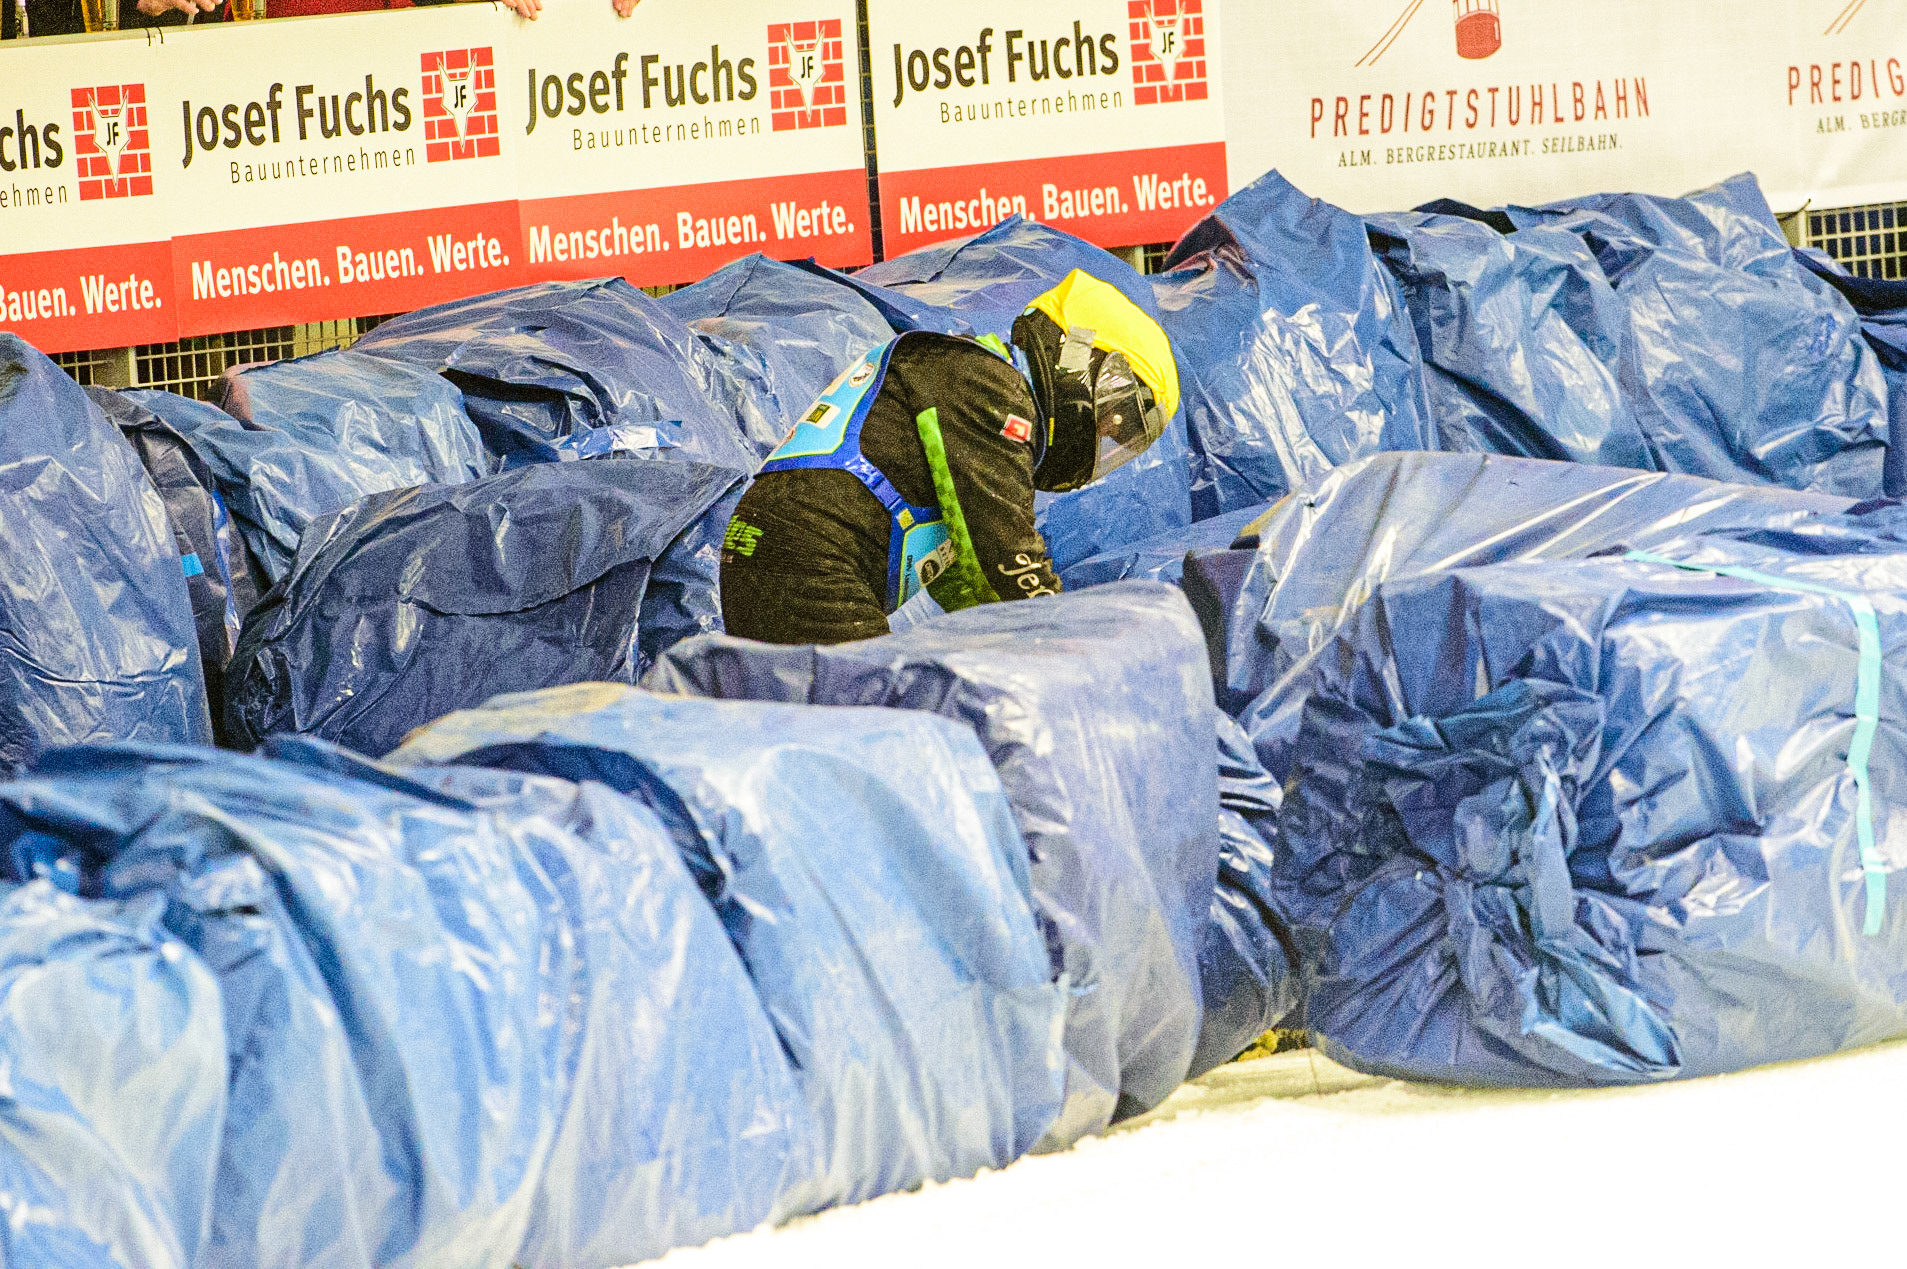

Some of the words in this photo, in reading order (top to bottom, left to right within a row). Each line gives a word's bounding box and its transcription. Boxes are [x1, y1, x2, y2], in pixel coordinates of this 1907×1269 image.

[1162, 31, 1176, 55] JF
[801, 55, 815, 80] JF
[893, 27, 993, 109] Josef
[1005, 20, 1119, 82] Fuchs
[455, 85, 466, 108] JF
[526, 52, 629, 135] Josef
[641, 45, 756, 108] Fuchs
[940, 89, 1121, 124] Bauunternehmen
[1310, 77, 1650, 139] PREDIGTSTUHLBAHN
[107, 122, 118, 145] JF
[183, 83, 282, 168] Josef
[296, 74, 411, 140] Fuchs
[573, 115, 759, 152] Bauunternehmen
[1816, 115, 1852, 134] ALM.
[231, 148, 414, 183] Bauunternehmen
[1338, 149, 1377, 168] ALM.
[1386, 139, 1535, 165] BERGRESTAURANT.
[1541, 133, 1623, 154] SEILBAHN.
[900, 187, 1036, 235] Menschen.
[1043, 184, 1128, 219] Bauen.
[1133, 173, 1214, 211] Werte.
[529, 217, 669, 263] Menschen.
[677, 212, 766, 248] Bauen.
[771, 201, 854, 239] Werte.
[192, 252, 330, 299] Menschen.
[336, 246, 423, 283] Bauen.
[427, 233, 509, 273] Werte.
[80, 274, 161, 314] Werte.
